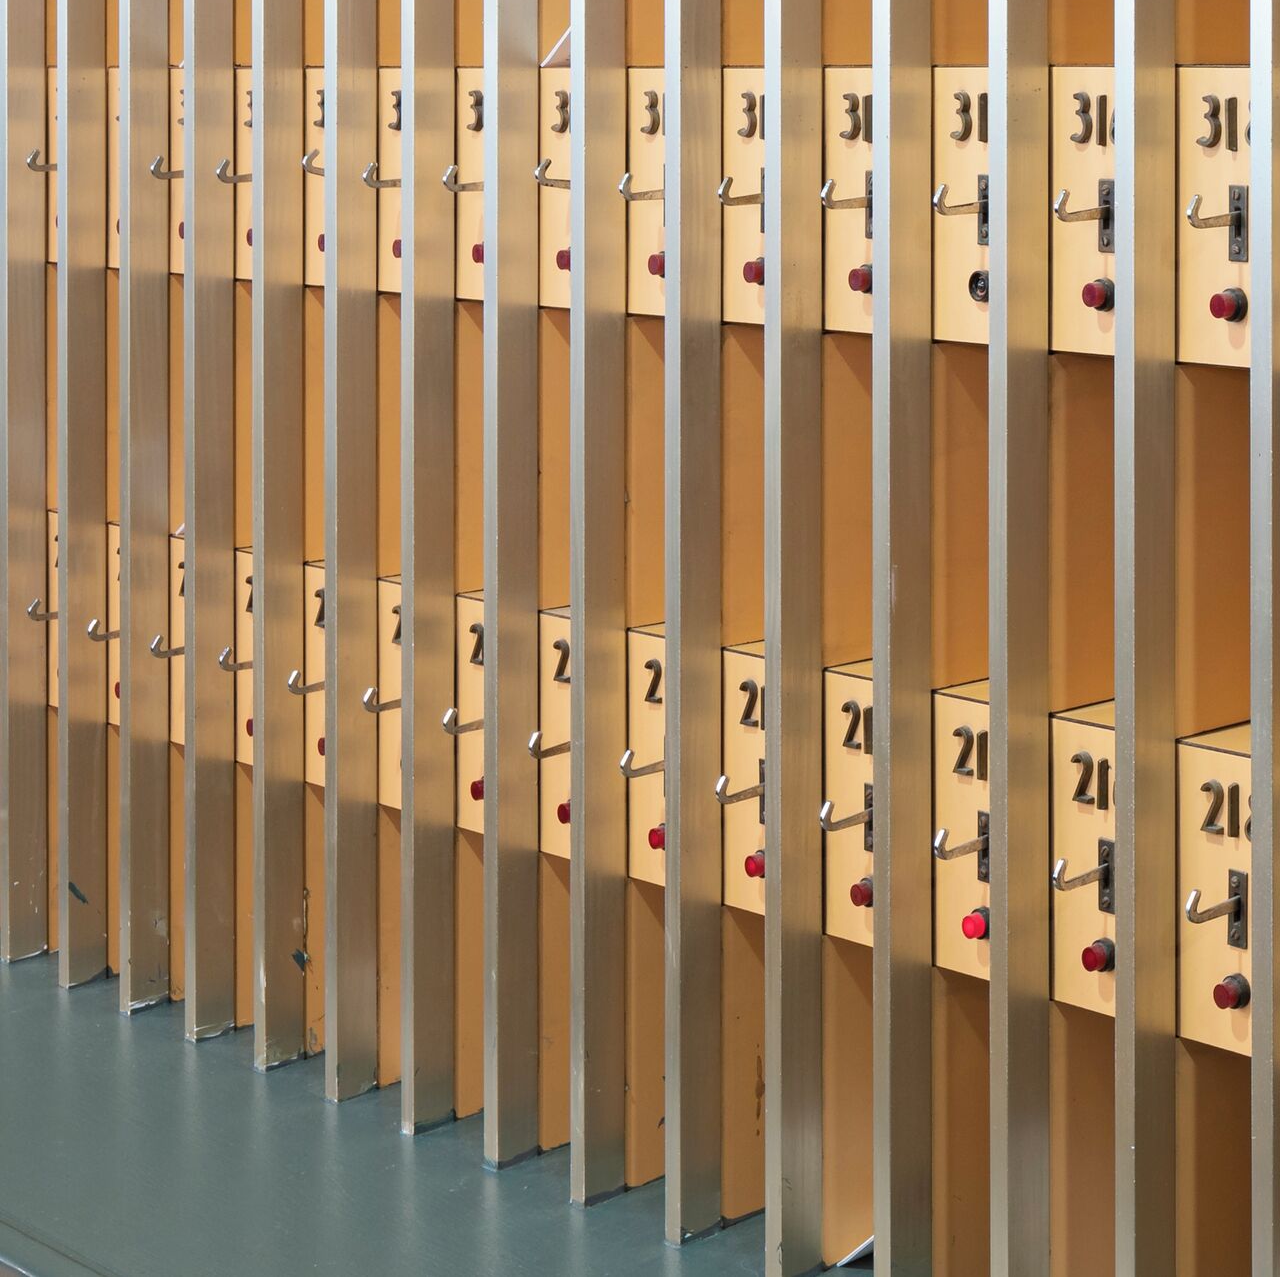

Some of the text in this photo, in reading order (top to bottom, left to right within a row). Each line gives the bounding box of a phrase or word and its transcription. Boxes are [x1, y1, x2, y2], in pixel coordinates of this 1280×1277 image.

[839, 93, 873, 144] 31
[950, 92, 988, 144] 31
[1070, 92, 1115, 147] 31
[1196, 94, 1250, 152] 31
[841, 699, 873, 755] 21
[952, 725, 989, 780] 21
[1070, 751, 1115, 810] 21
[1199, 778, 1251, 844] 21
